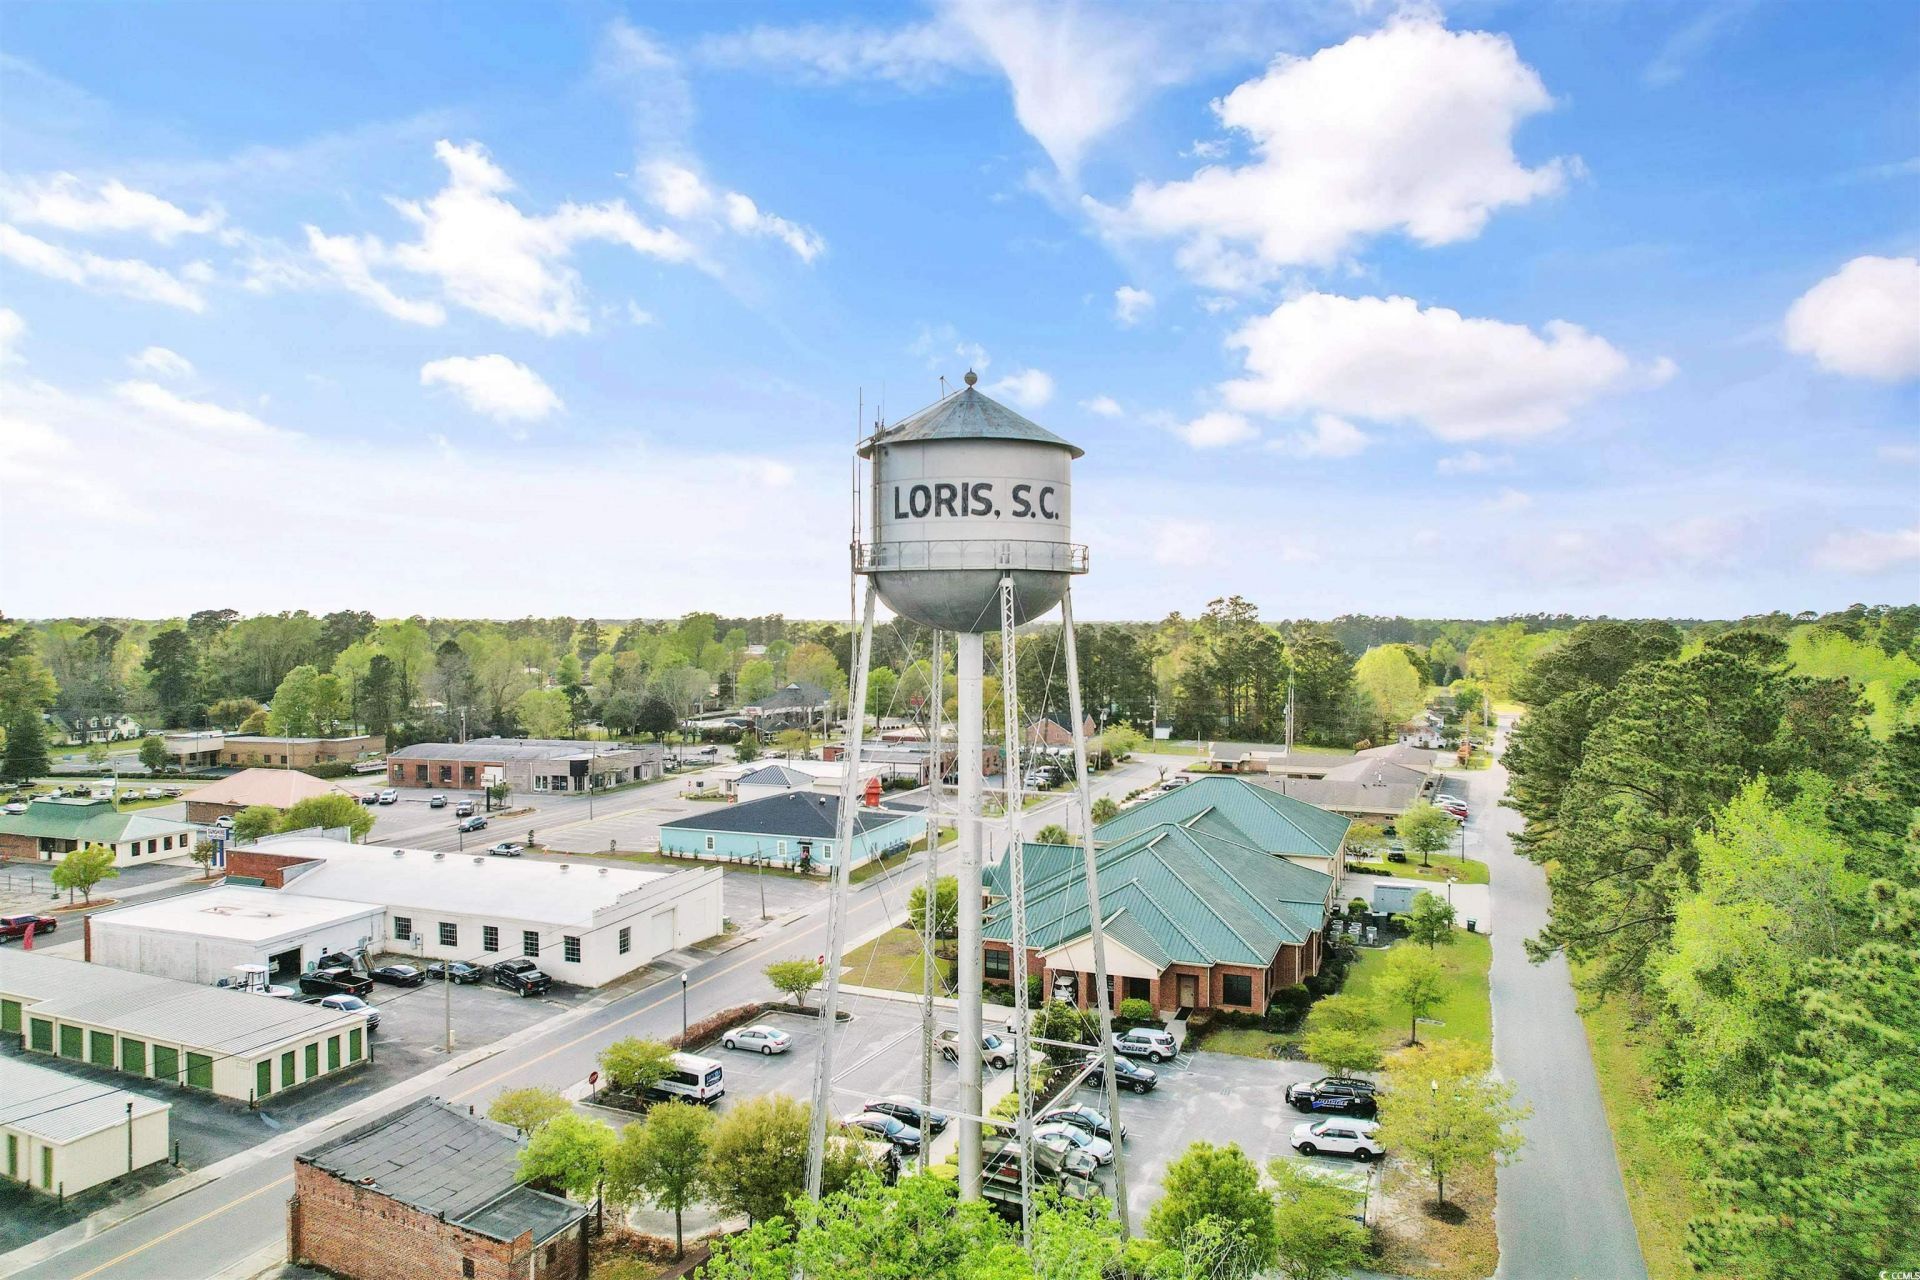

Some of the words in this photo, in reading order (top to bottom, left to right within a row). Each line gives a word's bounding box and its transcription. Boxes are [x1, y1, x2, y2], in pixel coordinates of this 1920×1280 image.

[894, 482, 1001, 520] LORIS,
[1012, 484, 1060, 520] S.C.
[1121, 1045, 1148, 1053] POLICE
